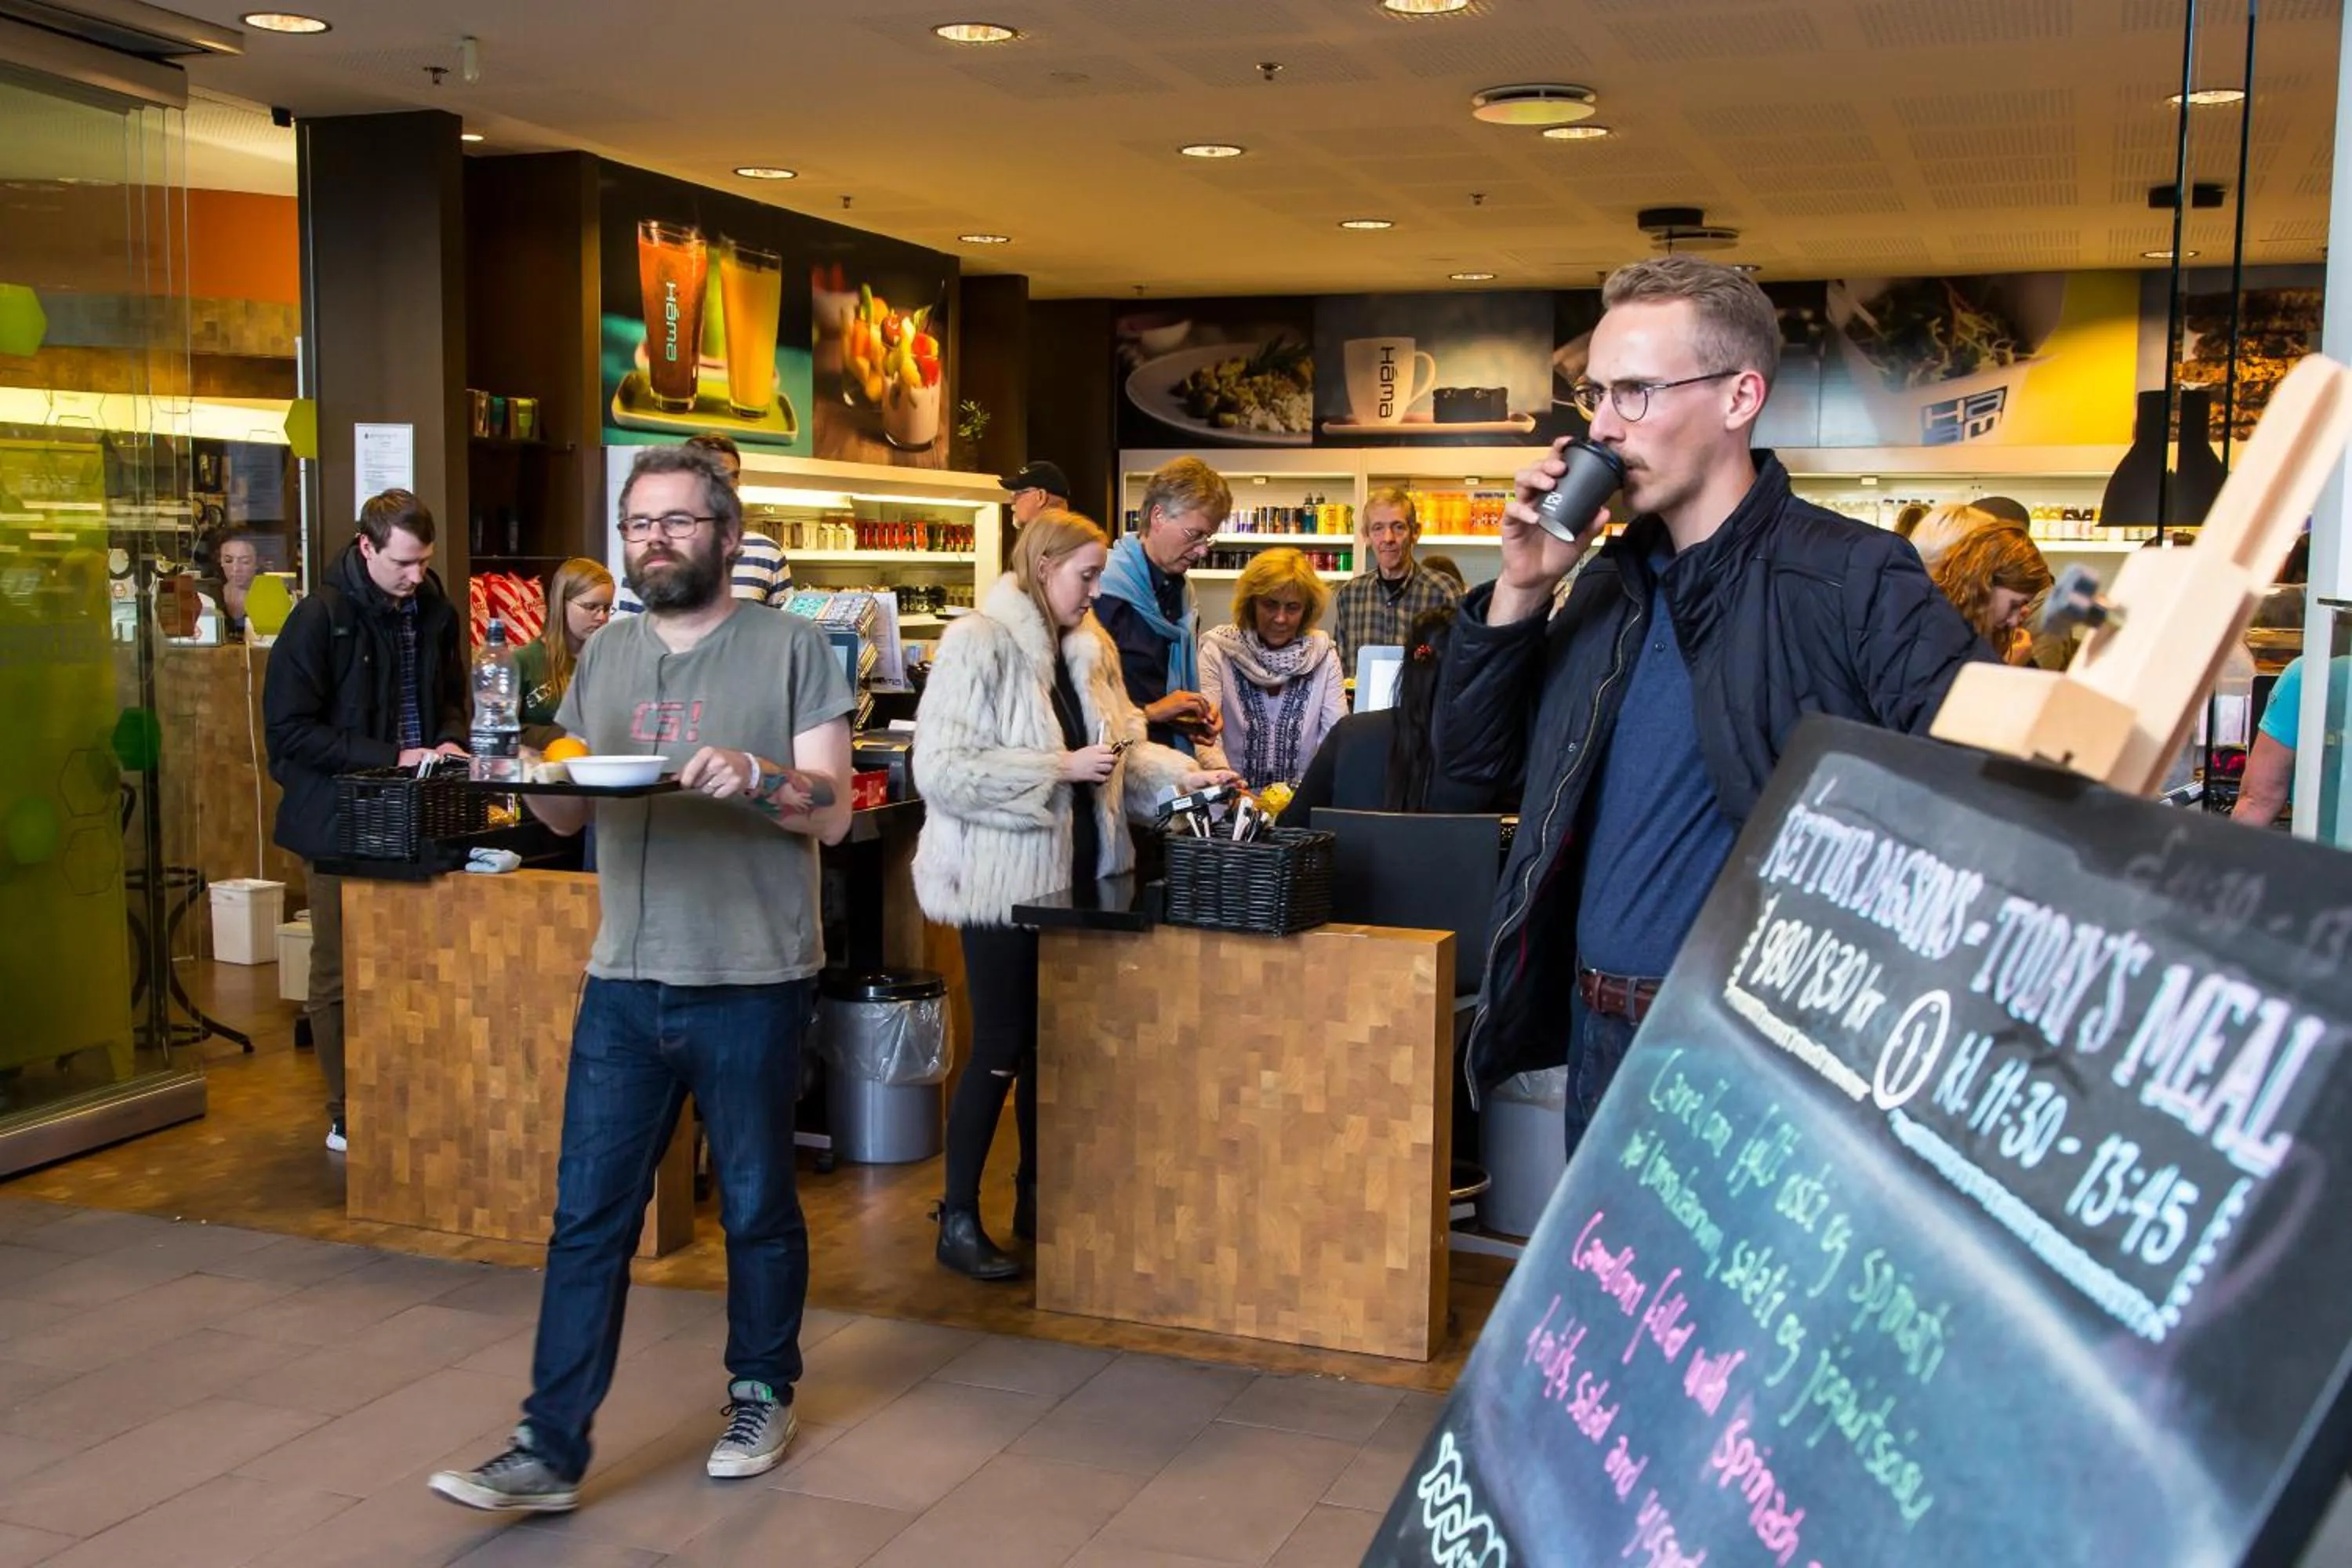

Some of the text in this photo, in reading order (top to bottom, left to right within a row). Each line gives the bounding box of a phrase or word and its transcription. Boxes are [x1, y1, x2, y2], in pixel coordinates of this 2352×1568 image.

[2112, 964, 2326, 1176] MEAL
[1967, 1057, 2067, 1168] 11:30
[2064, 1131, 2199, 1265] 13:45
[1806, 1212, 1853, 1298] og
[1764, 1313, 1807, 1388] og
